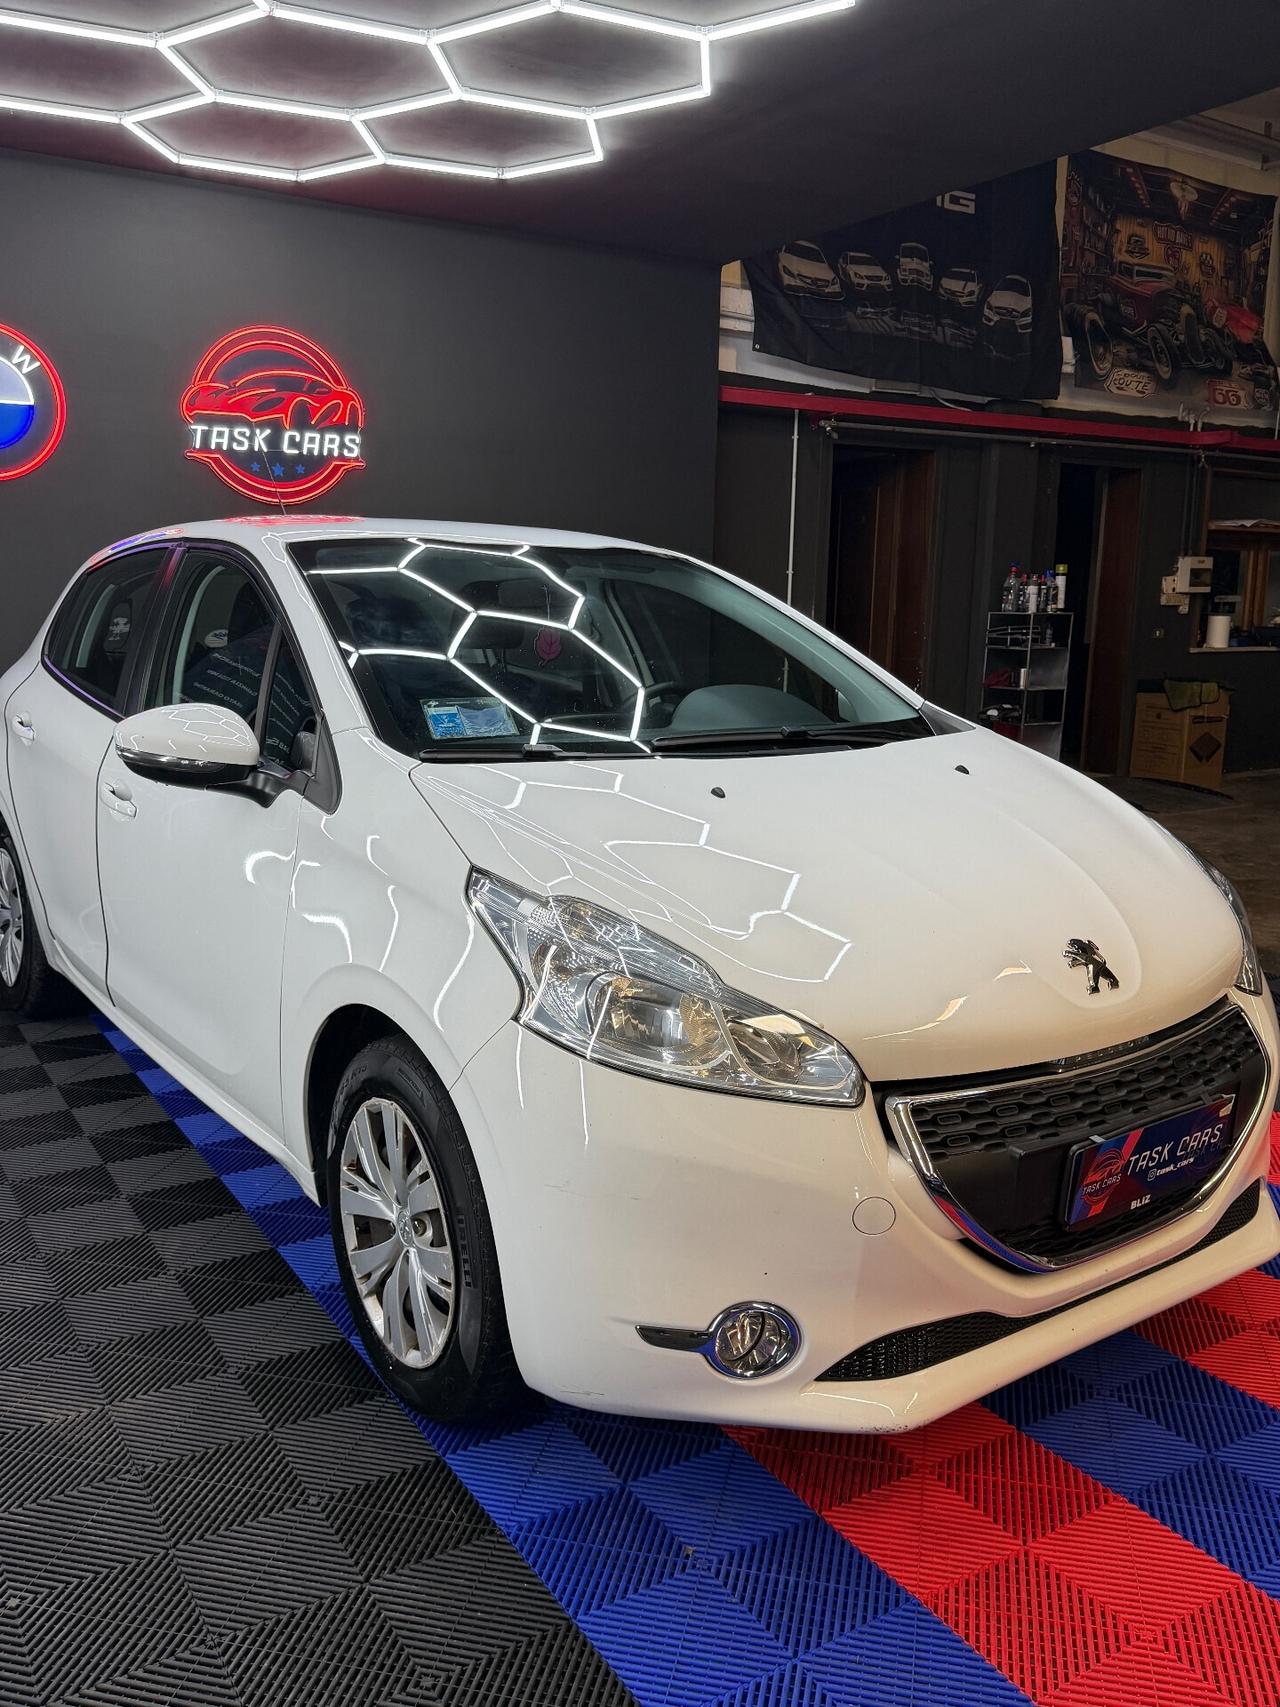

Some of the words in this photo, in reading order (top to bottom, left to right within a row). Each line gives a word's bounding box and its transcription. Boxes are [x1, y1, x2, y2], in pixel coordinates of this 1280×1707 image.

[191, 424, 273, 453] TASK
[283, 429, 362, 459] CARS
[1127, 1141, 1174, 1176] TASK
[1176, 1123, 1223, 1156] CARS
[1082, 1181, 1102, 1196] TASK
[1101, 1173, 1122, 1188] CARS
[1130, 1194, 1152, 1210] BLIZ
